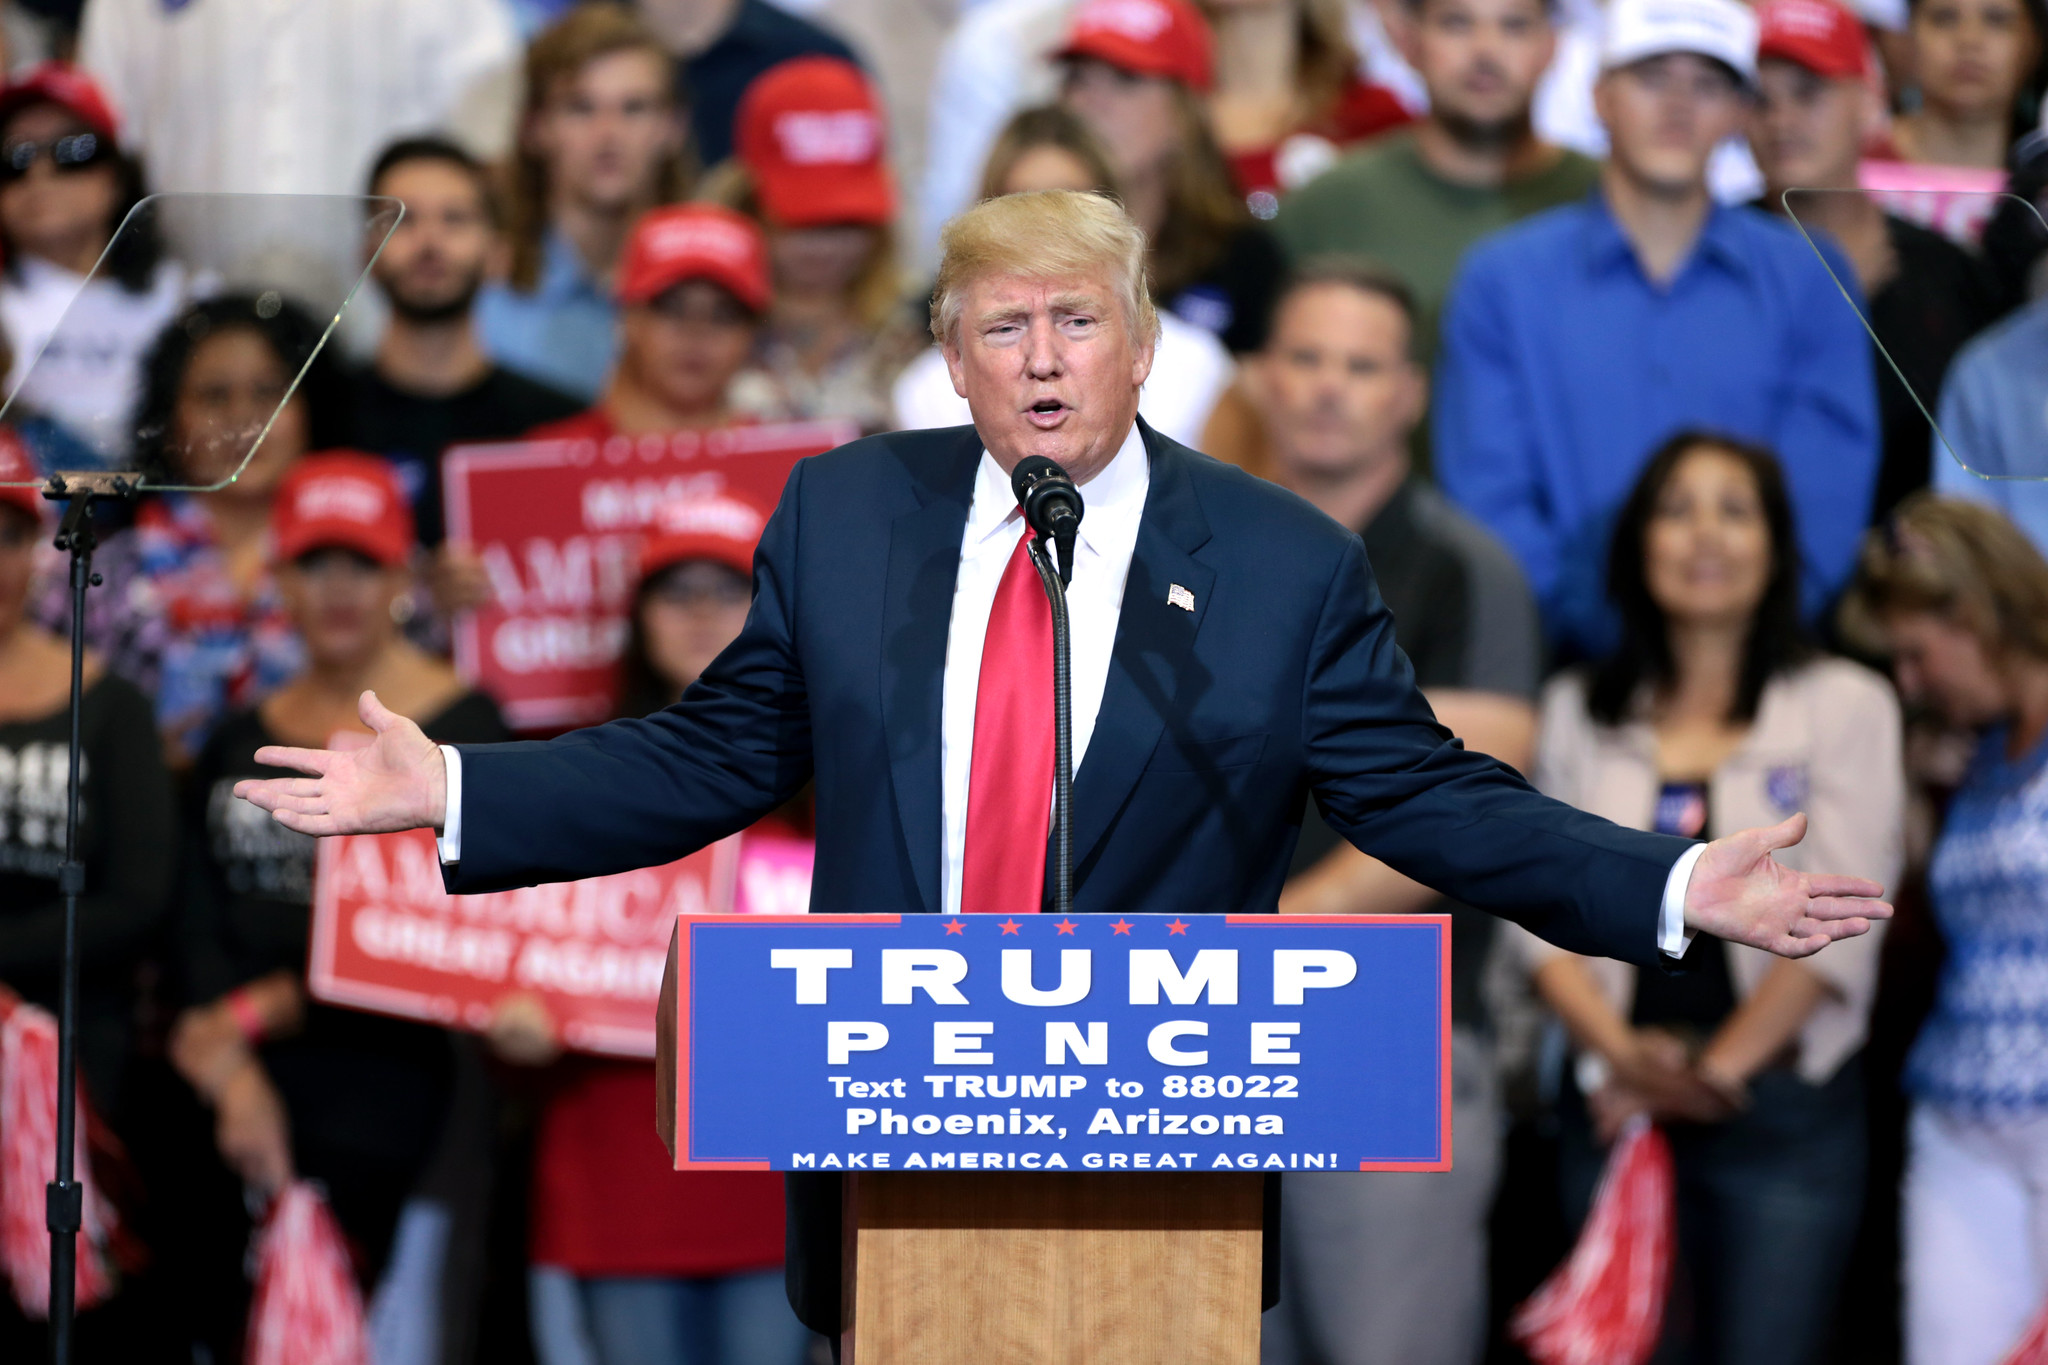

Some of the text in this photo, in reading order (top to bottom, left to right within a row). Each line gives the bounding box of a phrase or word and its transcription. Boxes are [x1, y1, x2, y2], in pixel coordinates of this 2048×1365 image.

[770, 948, 1358, 1007] TRUMP
[827, 1020, 1302, 1067] PENCE
[828, 1075, 1299, 1099] Text TRUMP to 88022
[846, 1107, 1285, 1140] Phoenix, Arizona
[792, 1152, 1338, 1169] MAKE AMERICA GREAT AGAIN!
